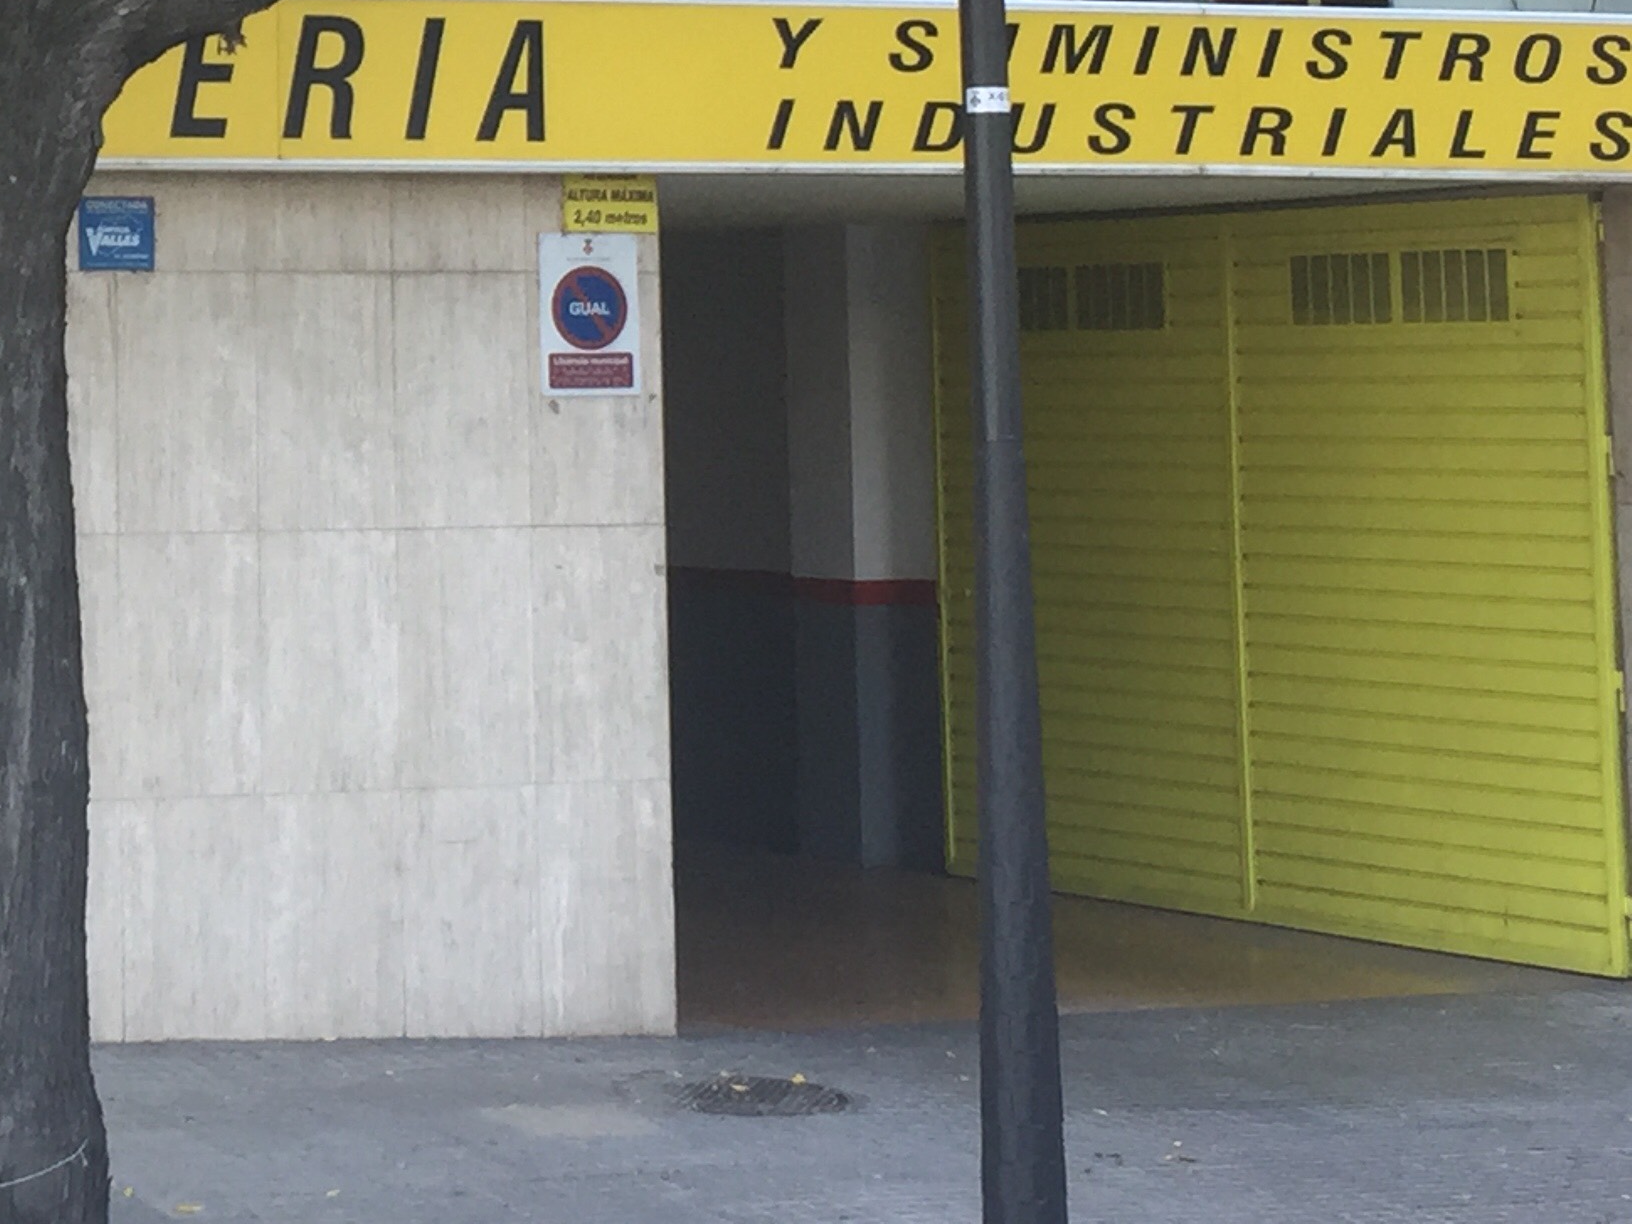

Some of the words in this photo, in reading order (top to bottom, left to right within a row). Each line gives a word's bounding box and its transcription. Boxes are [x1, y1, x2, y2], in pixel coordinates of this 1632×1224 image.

[772, 17, 823, 70] Y
[888, 19, 1632, 85] SMINISTROS
[767, 98, 1632, 161] INDUSTRIALES
[569, 302, 611, 316] GUAL
